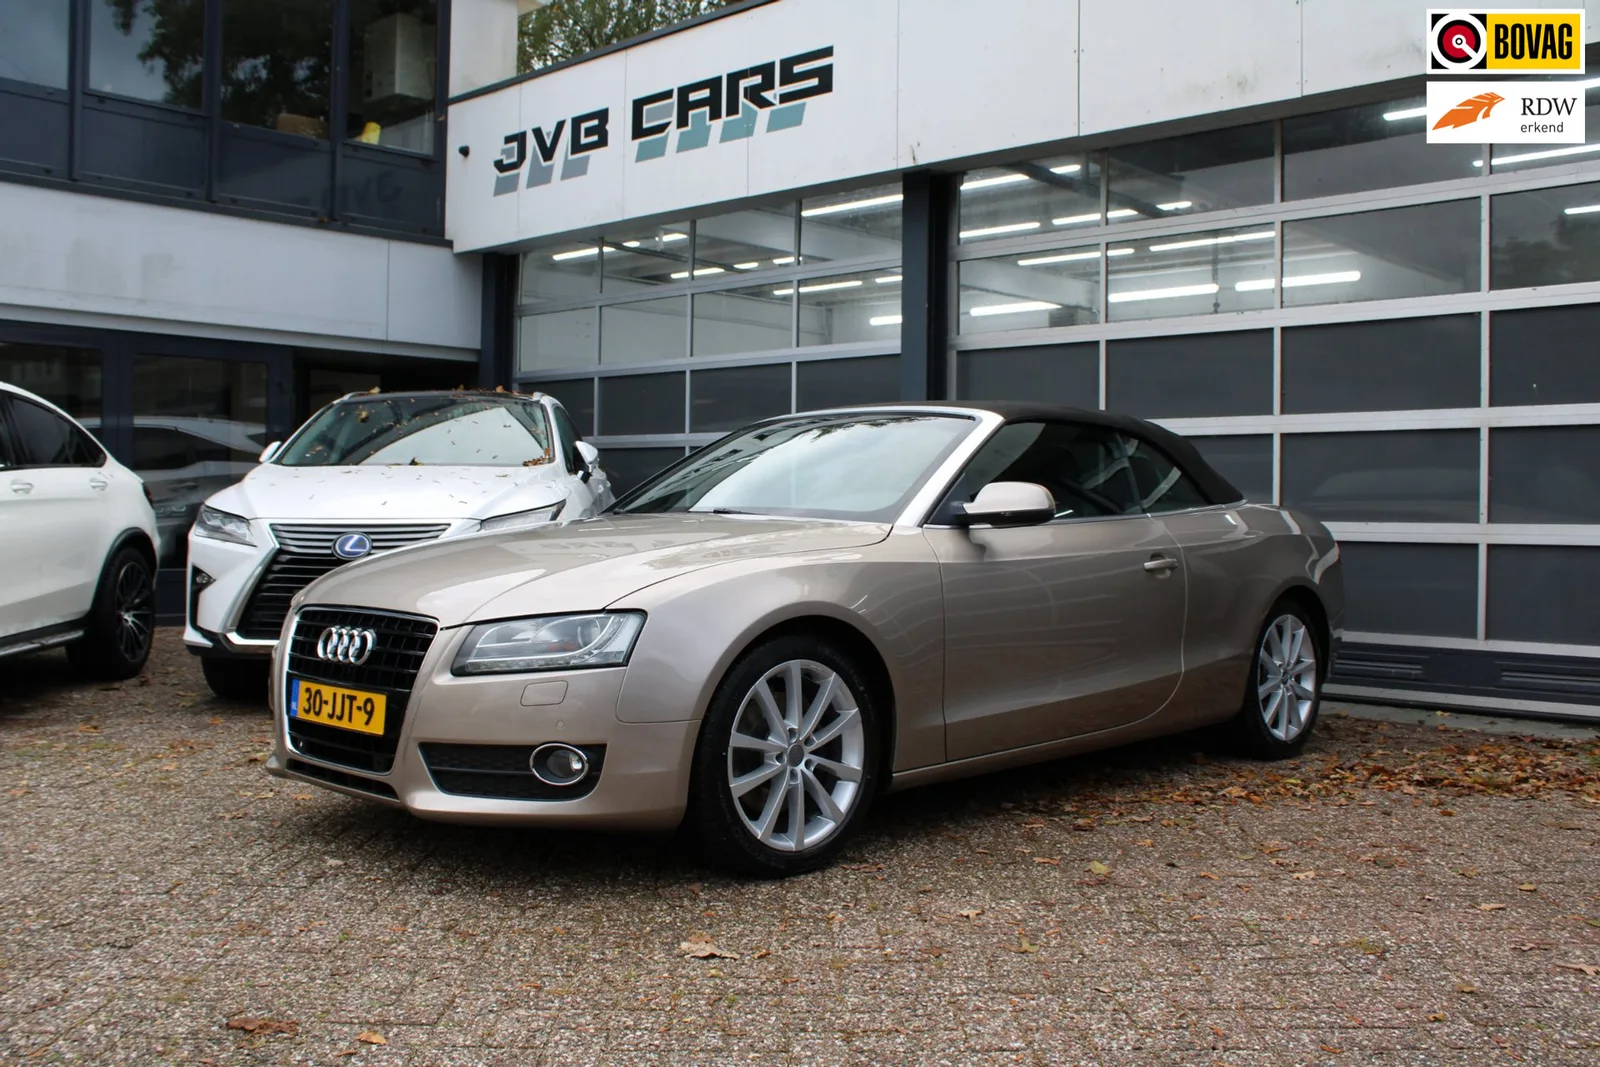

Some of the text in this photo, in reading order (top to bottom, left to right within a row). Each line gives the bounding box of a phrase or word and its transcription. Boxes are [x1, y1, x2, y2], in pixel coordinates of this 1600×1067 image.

[493, 45, 834, 174] JVB CARS
[302, 687, 375, 726] 30-JJT-9
